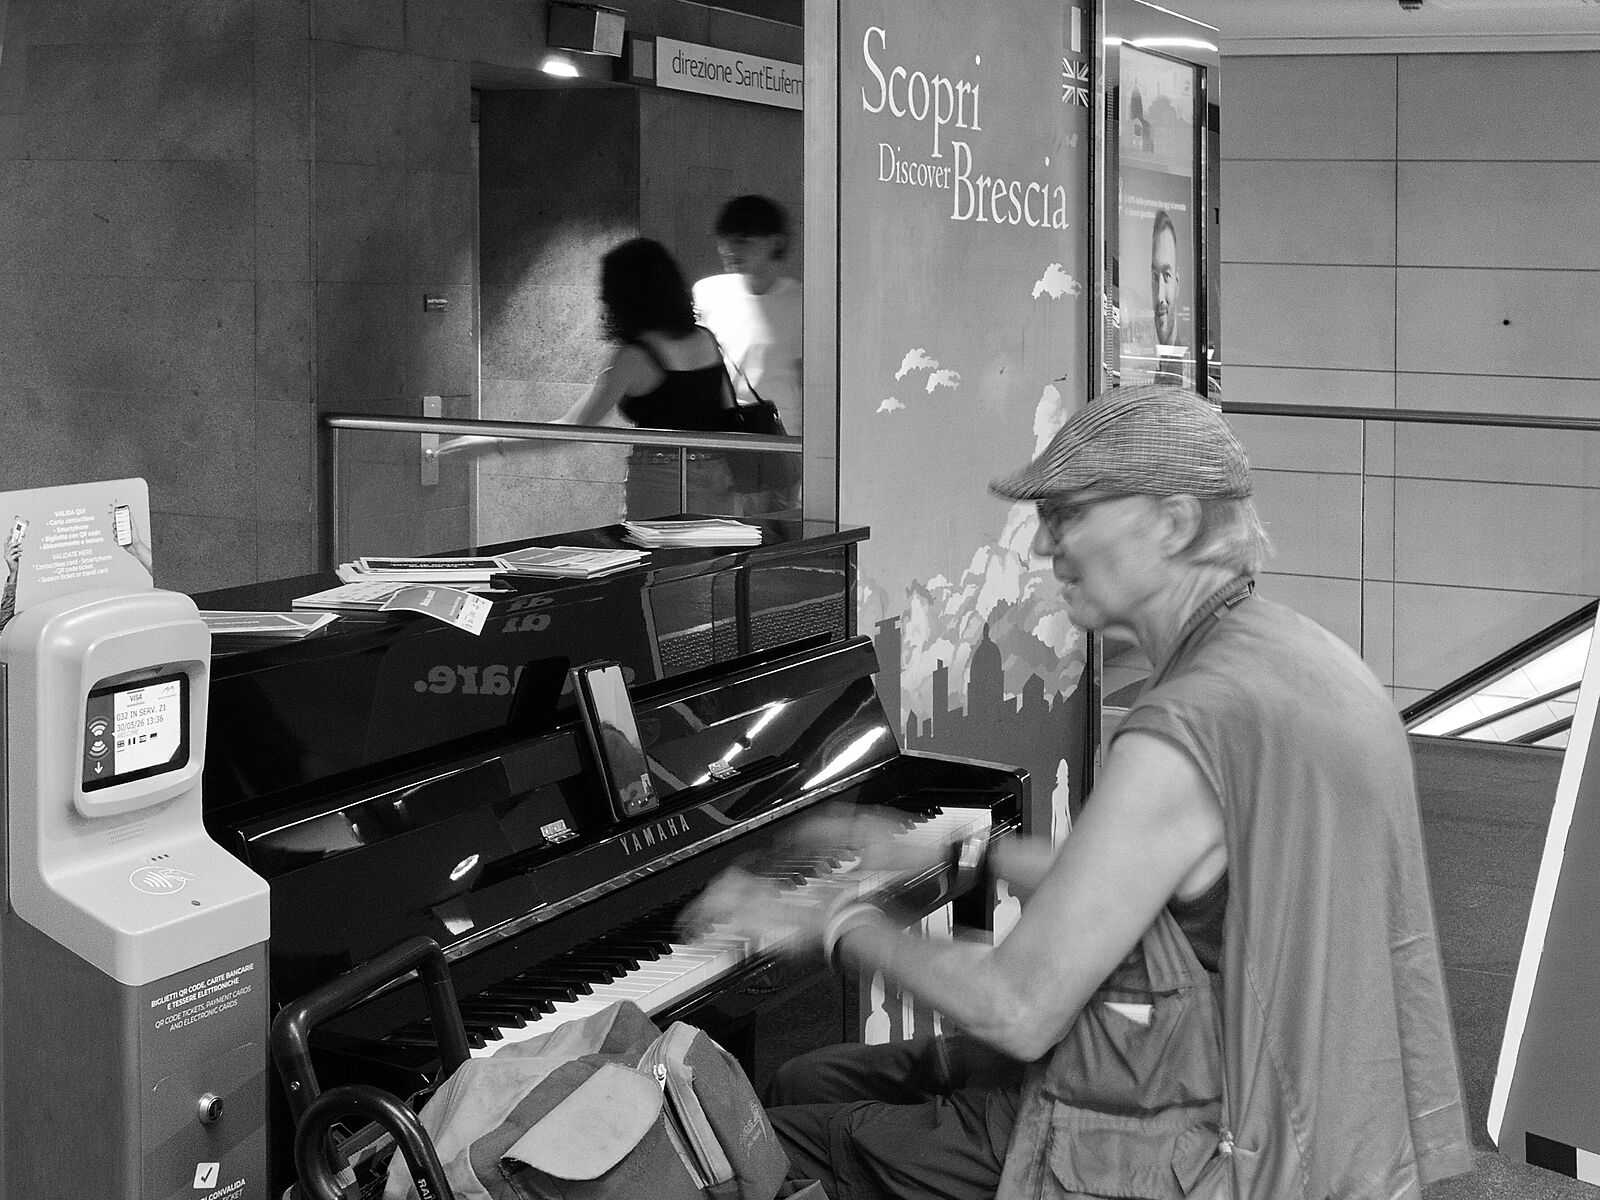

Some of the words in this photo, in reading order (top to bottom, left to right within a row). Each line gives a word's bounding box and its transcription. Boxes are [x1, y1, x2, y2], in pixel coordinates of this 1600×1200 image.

[672, 49, 732, 83] direzione
[861, 26, 982, 158] Scopri
[878, 142, 951, 189] Discover
[951, 140, 1069, 230] Brescia
[54, 509, 75, 517] VALIDA
[56, 525, 88, 533] Smartphone
[52, 550, 78, 560] VALIDATE
[130, 693, 142, 701] VISA
[117, 712, 128, 721] 032
[130, 709, 138, 718] IN
[620, 814, 690, 856] YAMAHA
[151, 992, 178, 1008] BIGLIETTI
[178, 988, 188, 997] QR
[206, 973, 225, 986] CARTE
[225, 963, 254, 979] BANCARIE
[167, 1002, 172, 1011] E
[172, 994, 197, 1009] TESSERE
[197, 977, 240, 998] ELETTRONICHE
[155, 1019, 164, 1029] QR
[164, 1012, 181, 1025] CODE
[206, 992, 233, 1008] PAYMENT
[232, 985, 252, 998] CARDS
[169, 1020, 183, 1031] AND
[183, 1007, 218, 1026] ELECTRONIC
[218, 999, 238, 1012] CARDS
